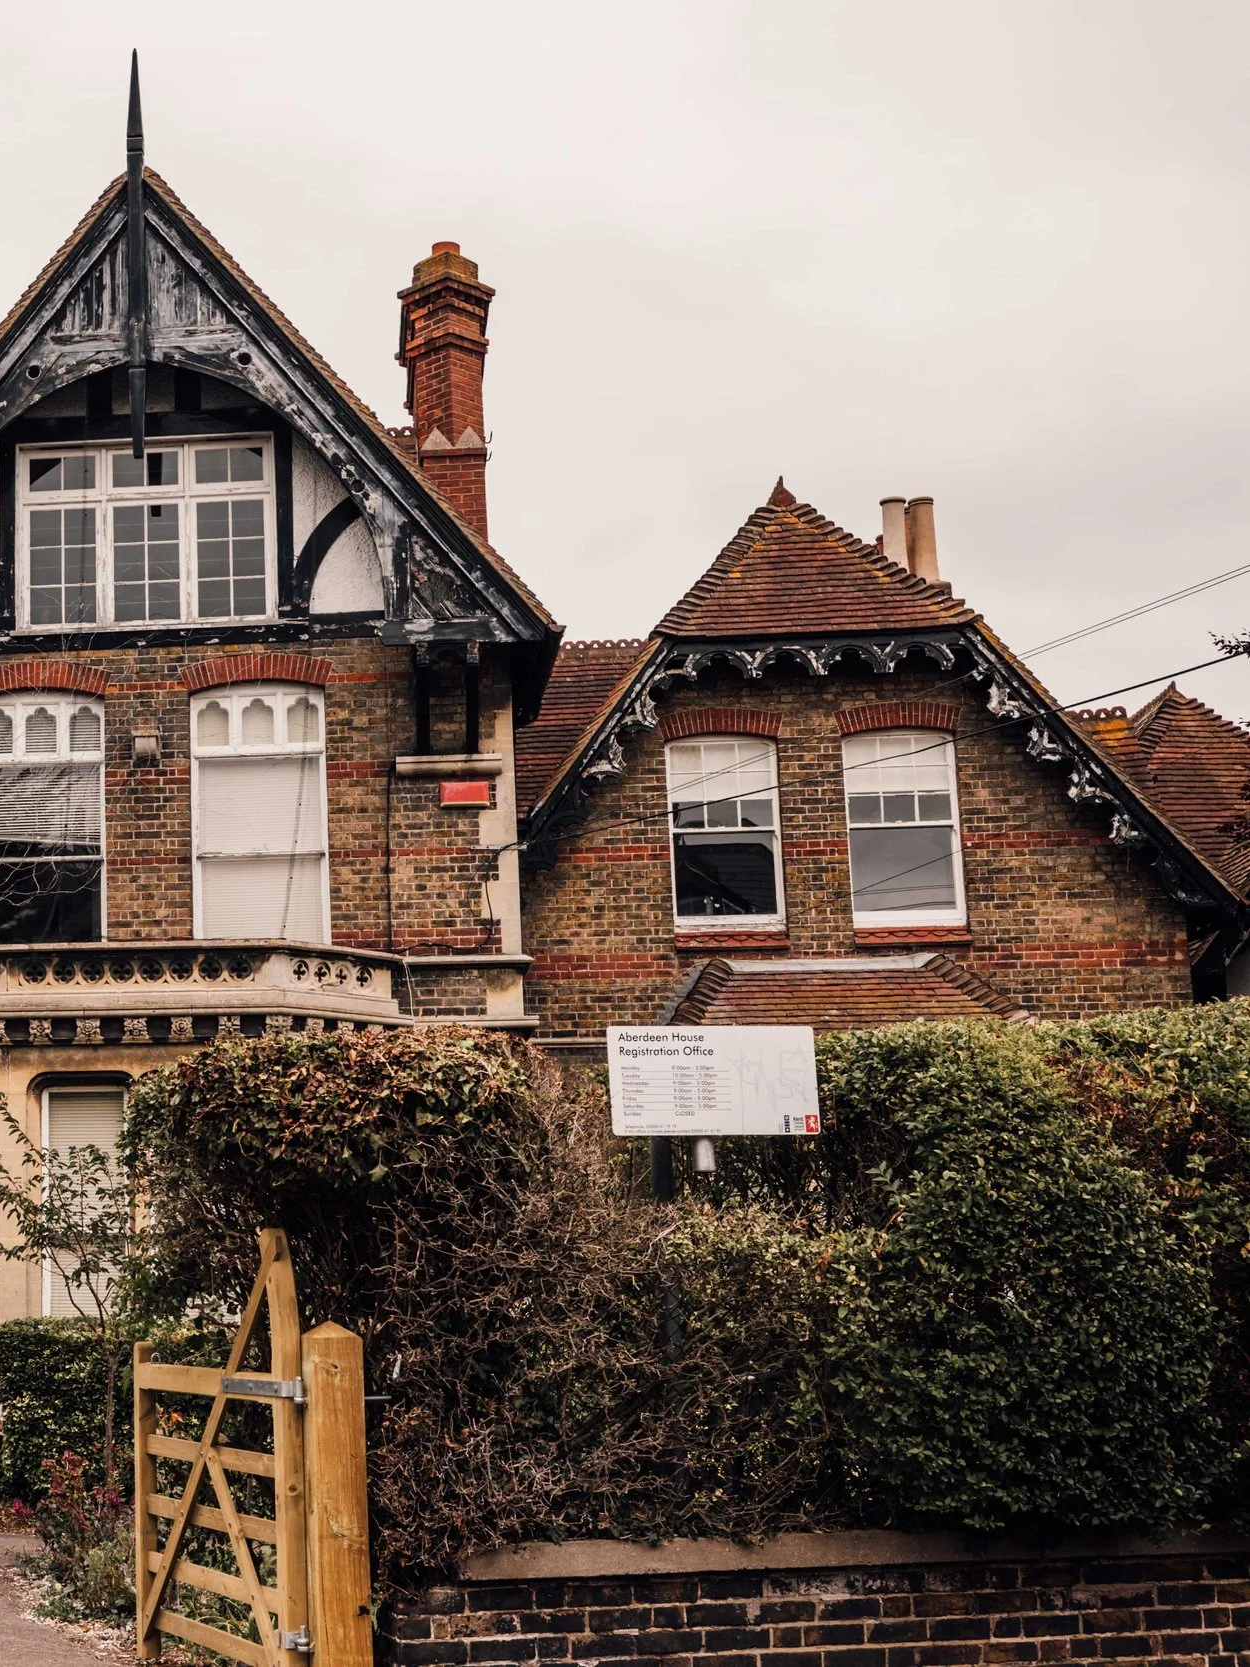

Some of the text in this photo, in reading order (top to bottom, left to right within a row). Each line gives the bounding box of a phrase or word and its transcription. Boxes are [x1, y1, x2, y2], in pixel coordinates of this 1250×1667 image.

[618, 1032, 704, 1042] Aberdeen House
[619, 1046, 714, 1058] Registration Office
